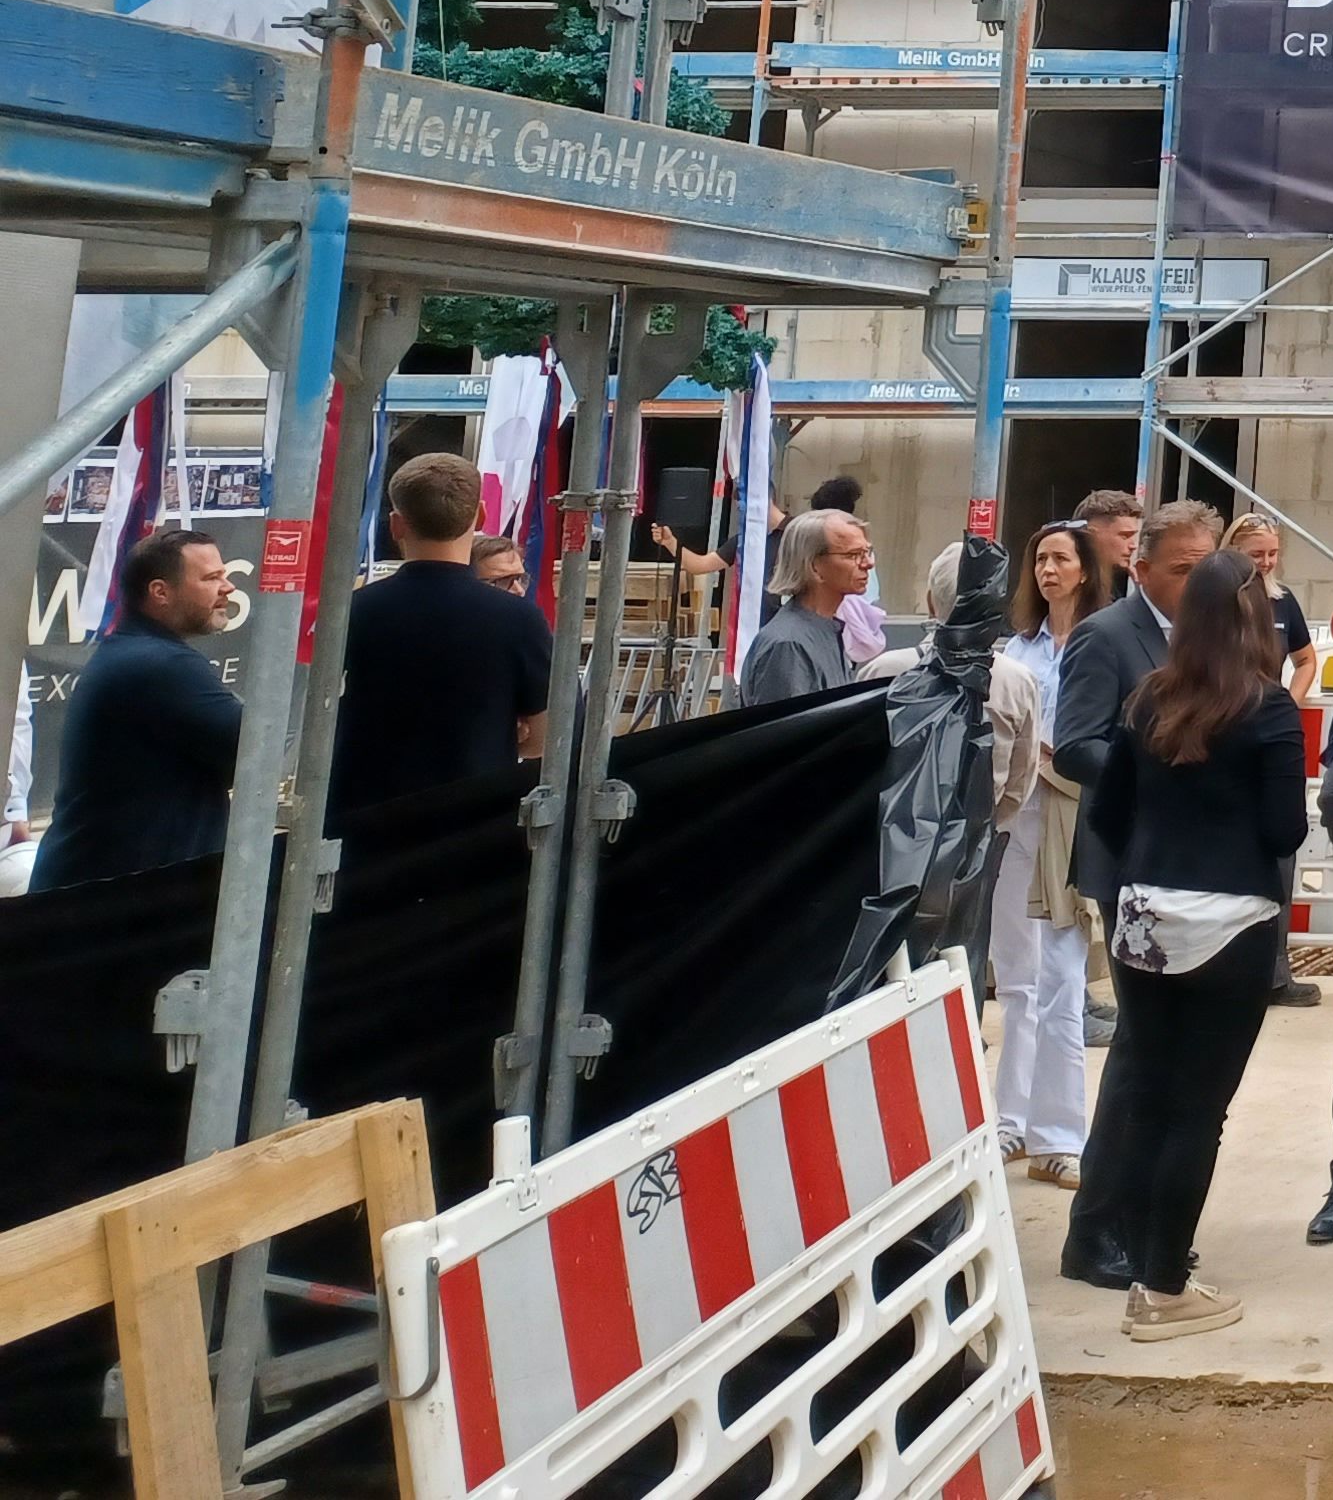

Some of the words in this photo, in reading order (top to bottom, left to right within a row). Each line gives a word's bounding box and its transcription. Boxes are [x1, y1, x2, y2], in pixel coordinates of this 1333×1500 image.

[898, 51, 942, 66] Melik
[947, 51, 1000, 67] GmbH
[373, 92, 502, 168] Melik
[514, 119, 645, 191] GmbH
[652, 144, 737, 206] Köln
[1092, 267, 1146, 284] KLAUS
[1163, 268, 1195, 285] FEIL
[458, 380, 490, 396] Mel
[870, 384, 915, 398] Melik
